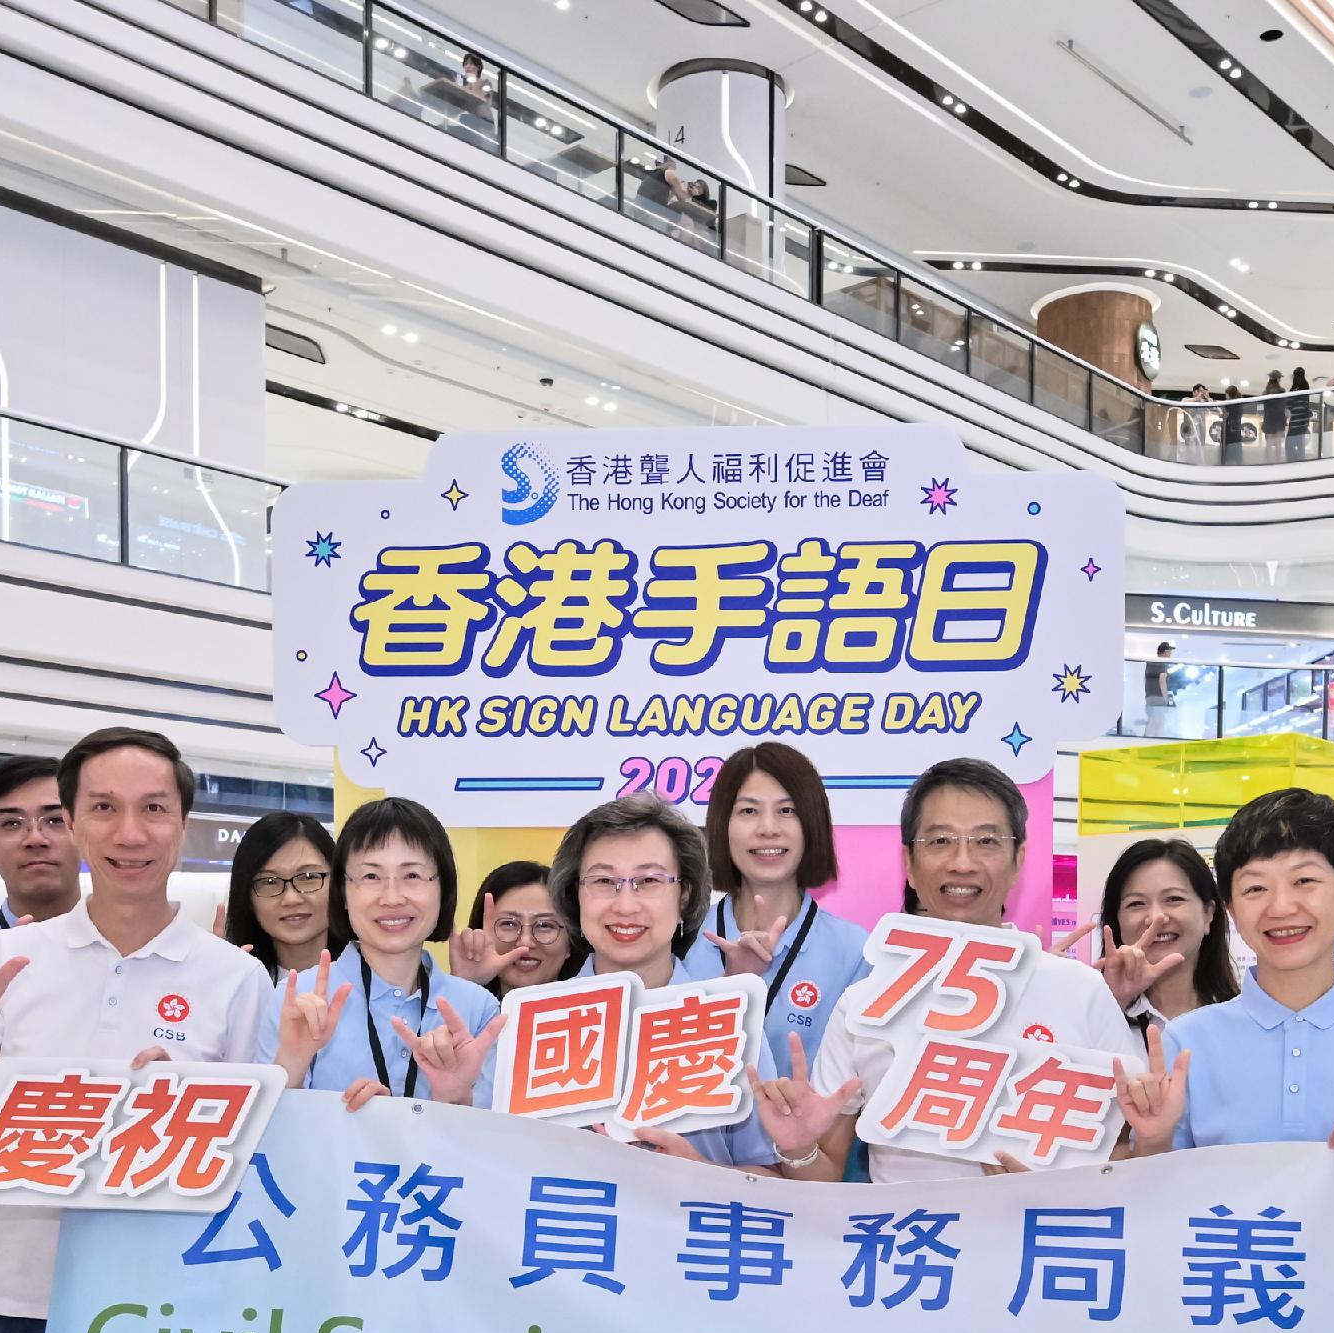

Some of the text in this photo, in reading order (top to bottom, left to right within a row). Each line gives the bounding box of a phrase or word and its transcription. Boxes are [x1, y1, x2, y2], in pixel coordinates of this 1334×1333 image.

[566, 451, 890, 486] 香港聾人福利促進會
[567, 489, 889, 515] The Hong Kong Society for the Deaf
[350, 538, 1048, 678] 香港手語日
[397, 691, 983, 737] HK SIGN LANGUAGE DAY
[616, 756, 724, 806] 202
[218, 828, 247, 844] DA
[861, 922, 1014, 1032] 75
[153, 1027, 187, 1042] CSB
[786, 1012, 813, 1028] CSB
[510, 986, 742, 1123] 國慶
[879, 1040, 1116, 1157] 周年
